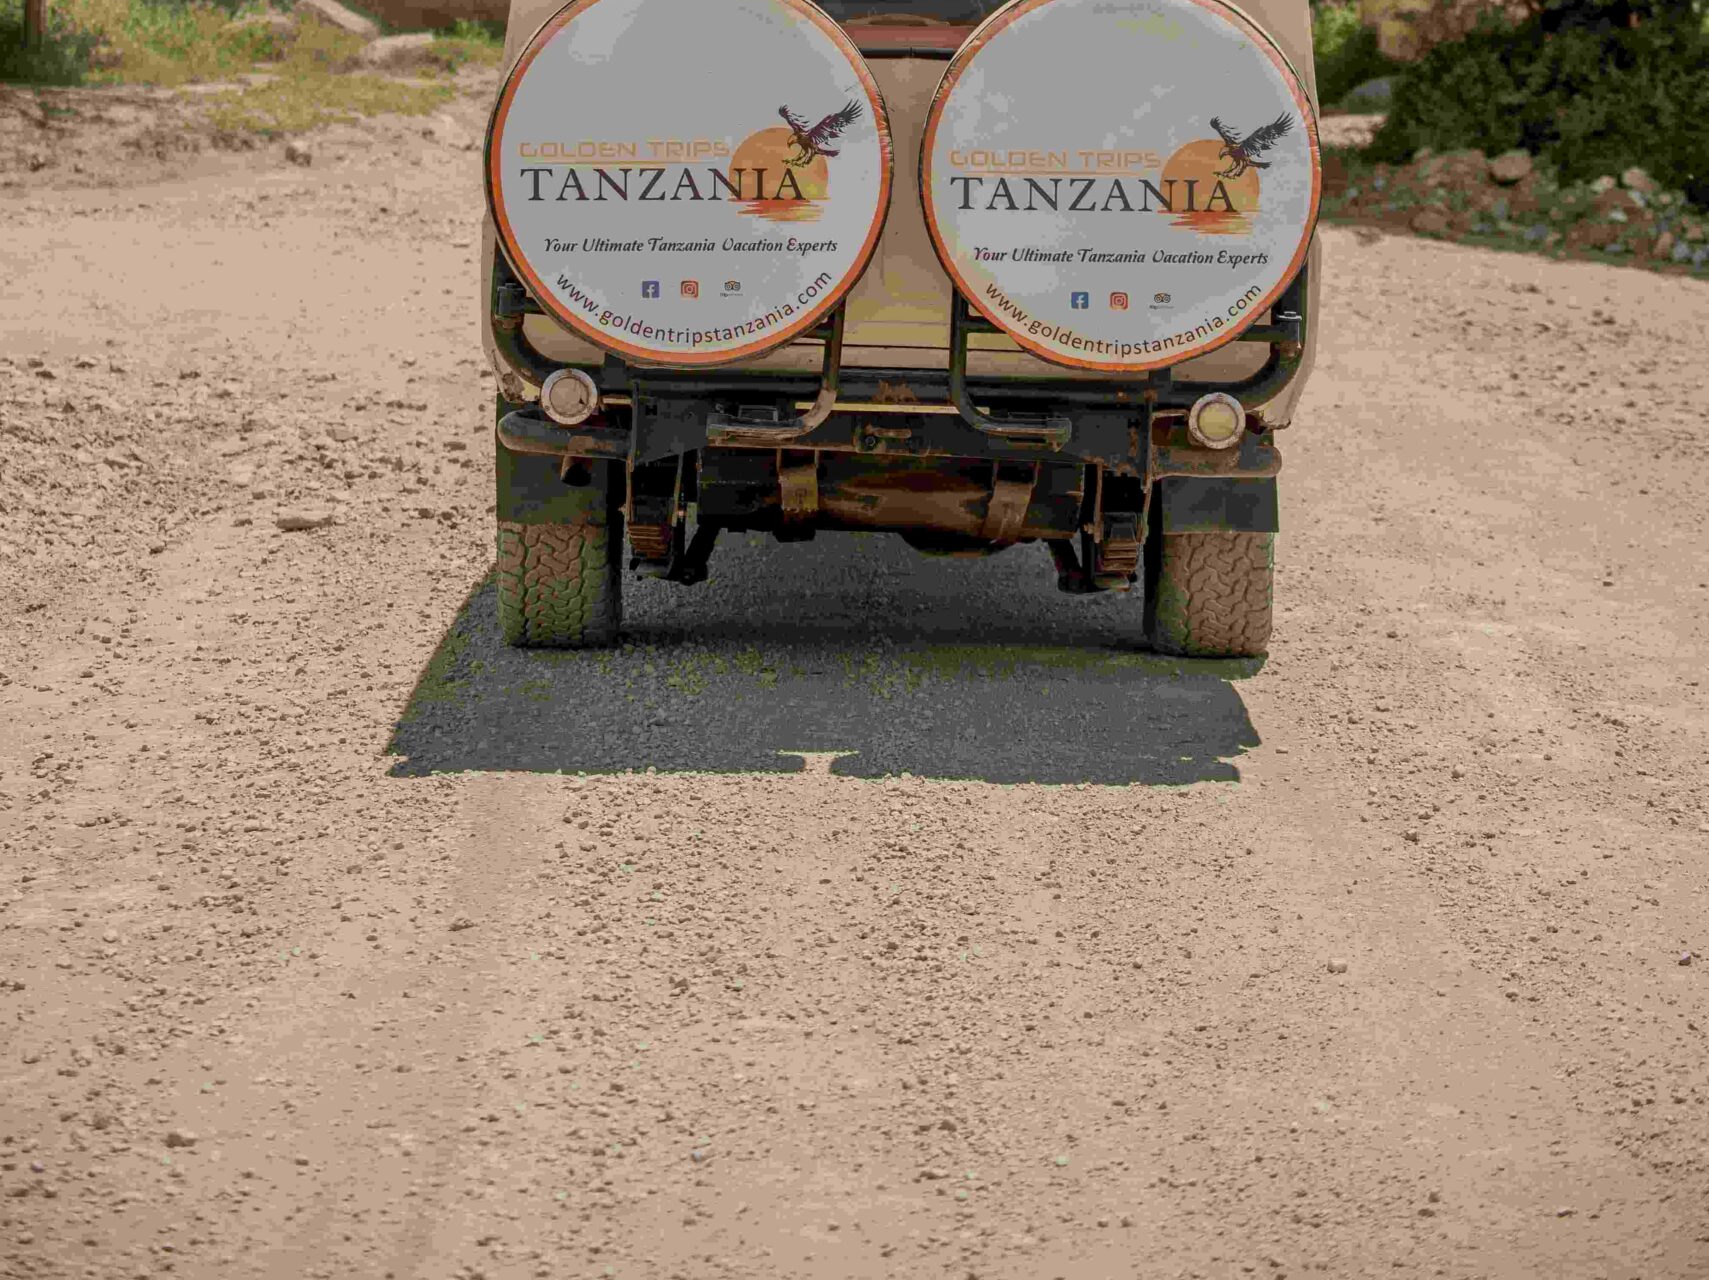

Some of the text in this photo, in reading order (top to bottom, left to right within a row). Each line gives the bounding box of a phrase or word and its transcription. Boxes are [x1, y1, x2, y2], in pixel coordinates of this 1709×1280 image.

[519, 141, 731, 158] GOLDEN TRIPS
[950, 150, 1161, 169] GOLDEN TRIPS
[519, 167, 807, 201] TANZANIA
[949, 176, 1238, 213] TANZANIA
[544, 236, 838, 257] Your Ultimate Tanzania Vacation Experts
[973, 246, 1268, 269] Your Ultimate Tanzania Vacation Experts
[556, 270, 833, 347] www.goldentripstanzania.com
[985, 283, 1262, 358] www.goldentripstanzania.com
